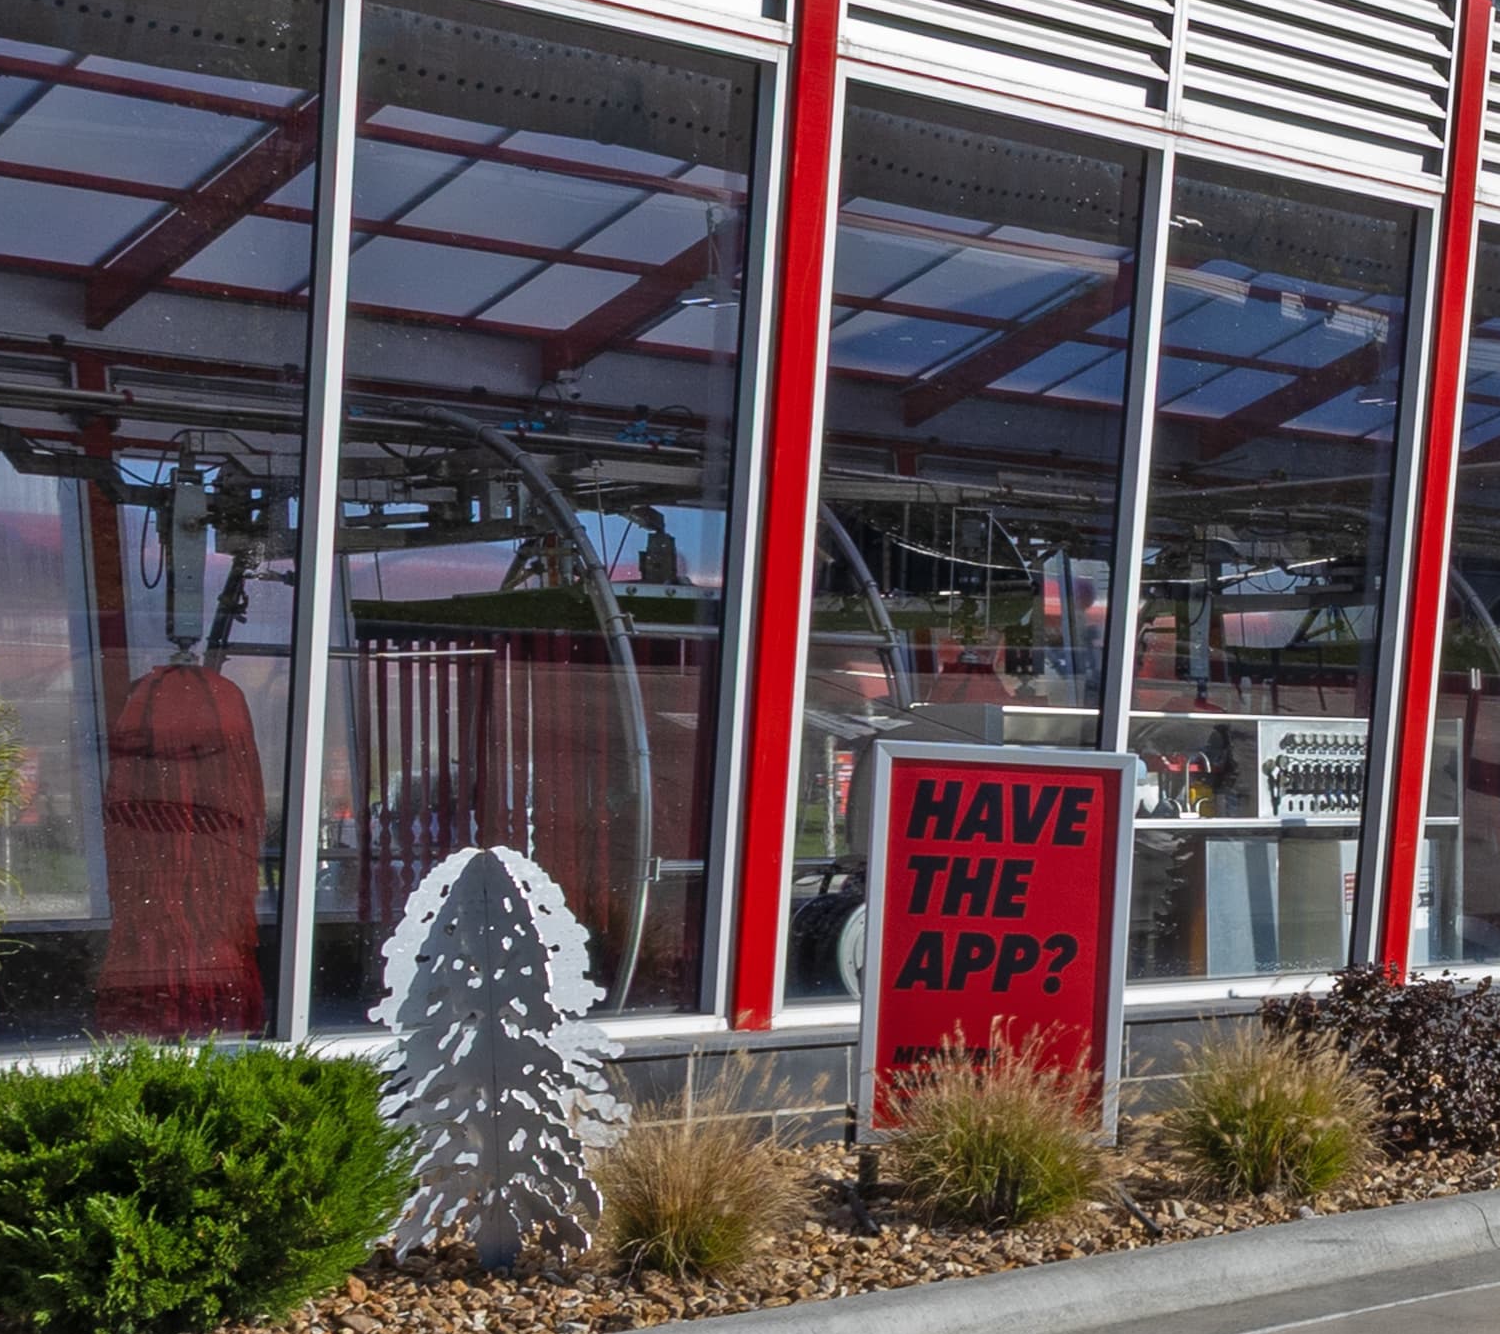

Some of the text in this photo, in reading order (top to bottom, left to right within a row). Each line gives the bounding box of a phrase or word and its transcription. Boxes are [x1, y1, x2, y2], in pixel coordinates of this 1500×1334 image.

[906, 779, 1094, 846] HAVE
[907, 855, 1036, 918] THE
[895, 931, 1078, 995] APP?
